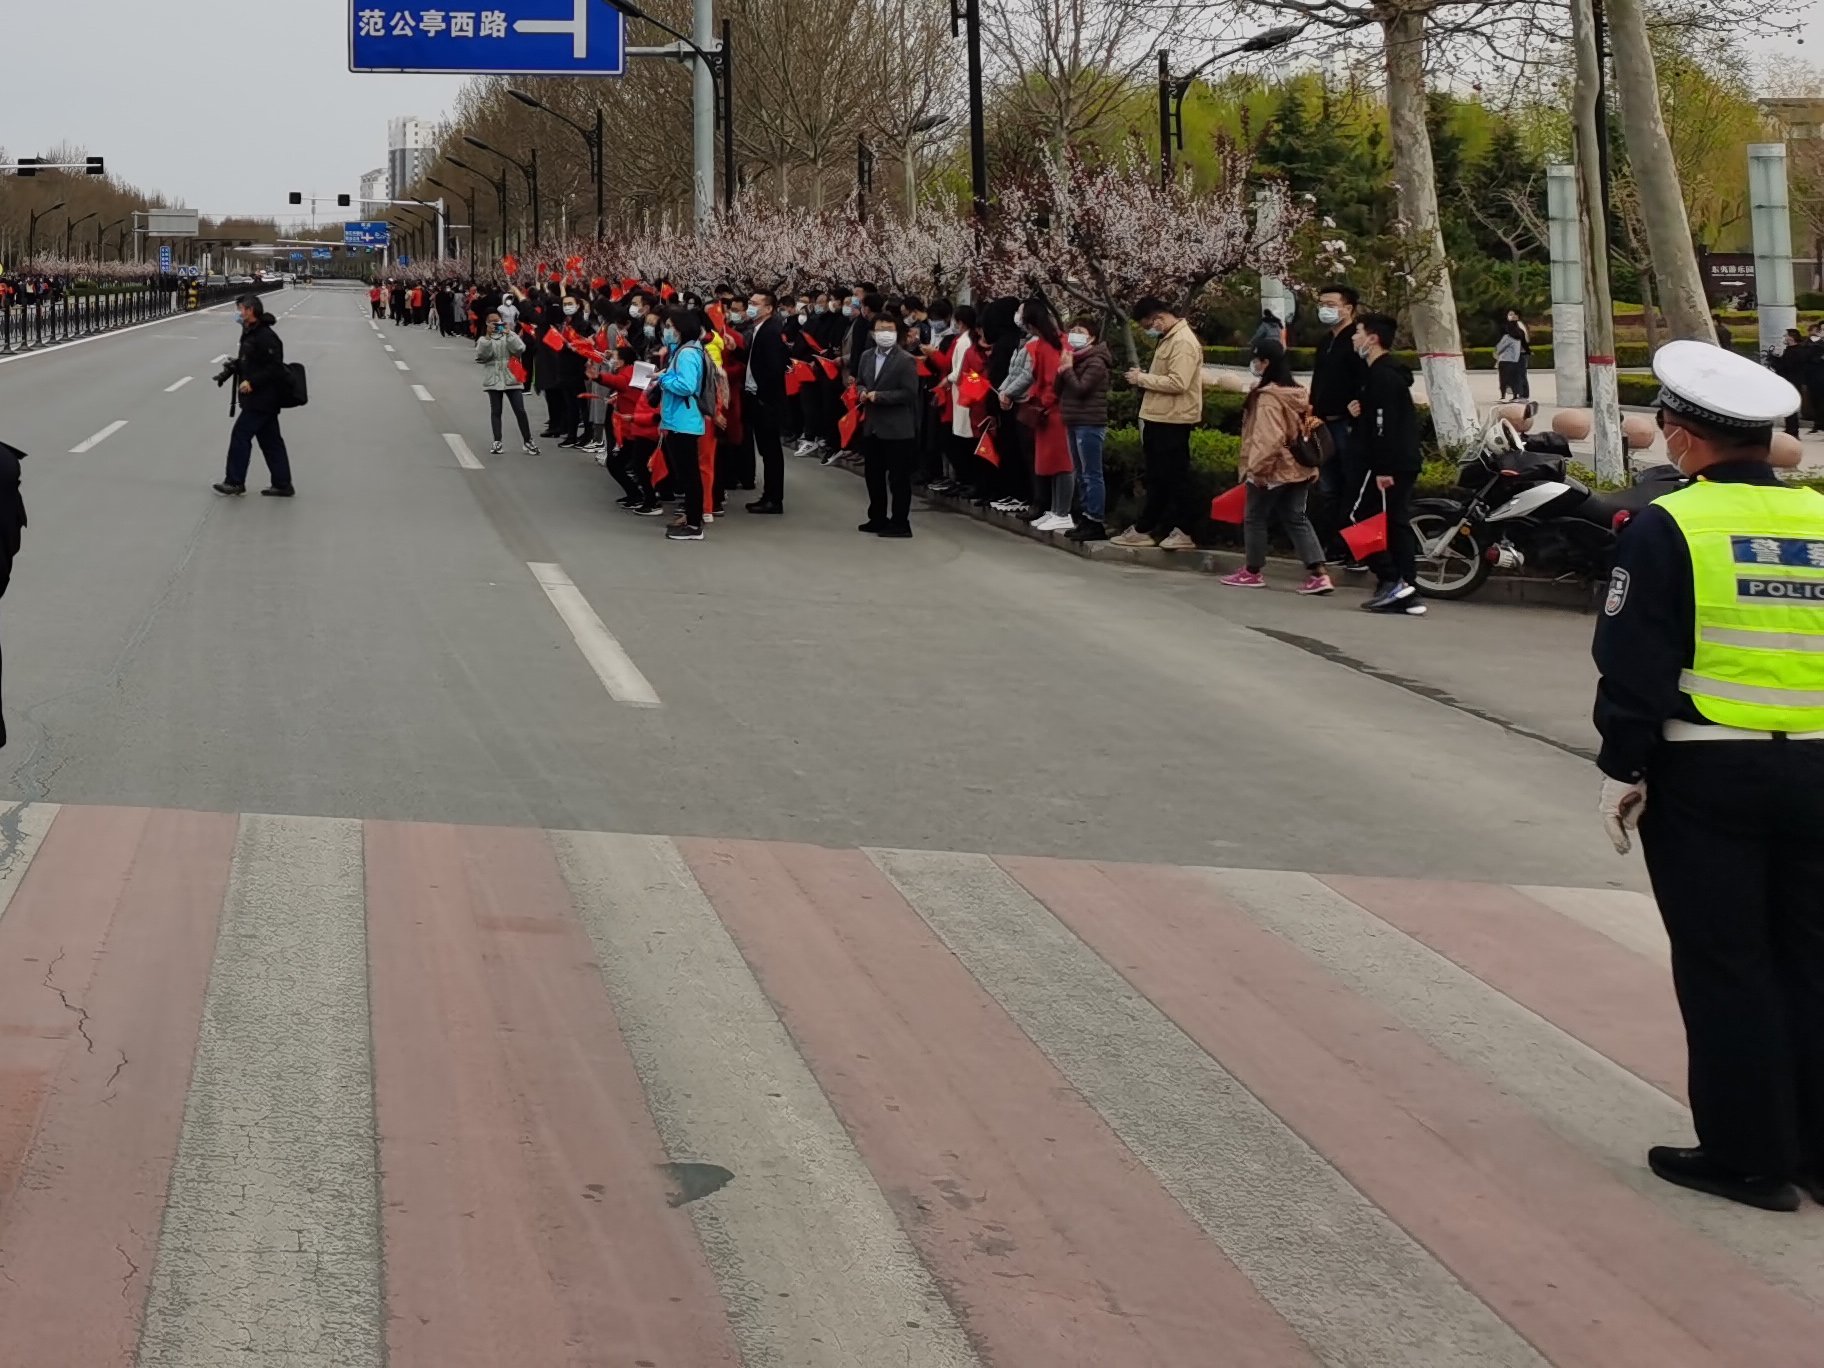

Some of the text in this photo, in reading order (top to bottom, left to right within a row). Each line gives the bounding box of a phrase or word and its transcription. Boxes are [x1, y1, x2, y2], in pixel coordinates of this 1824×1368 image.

[358, 9, 508, 38] 范公亭西路
